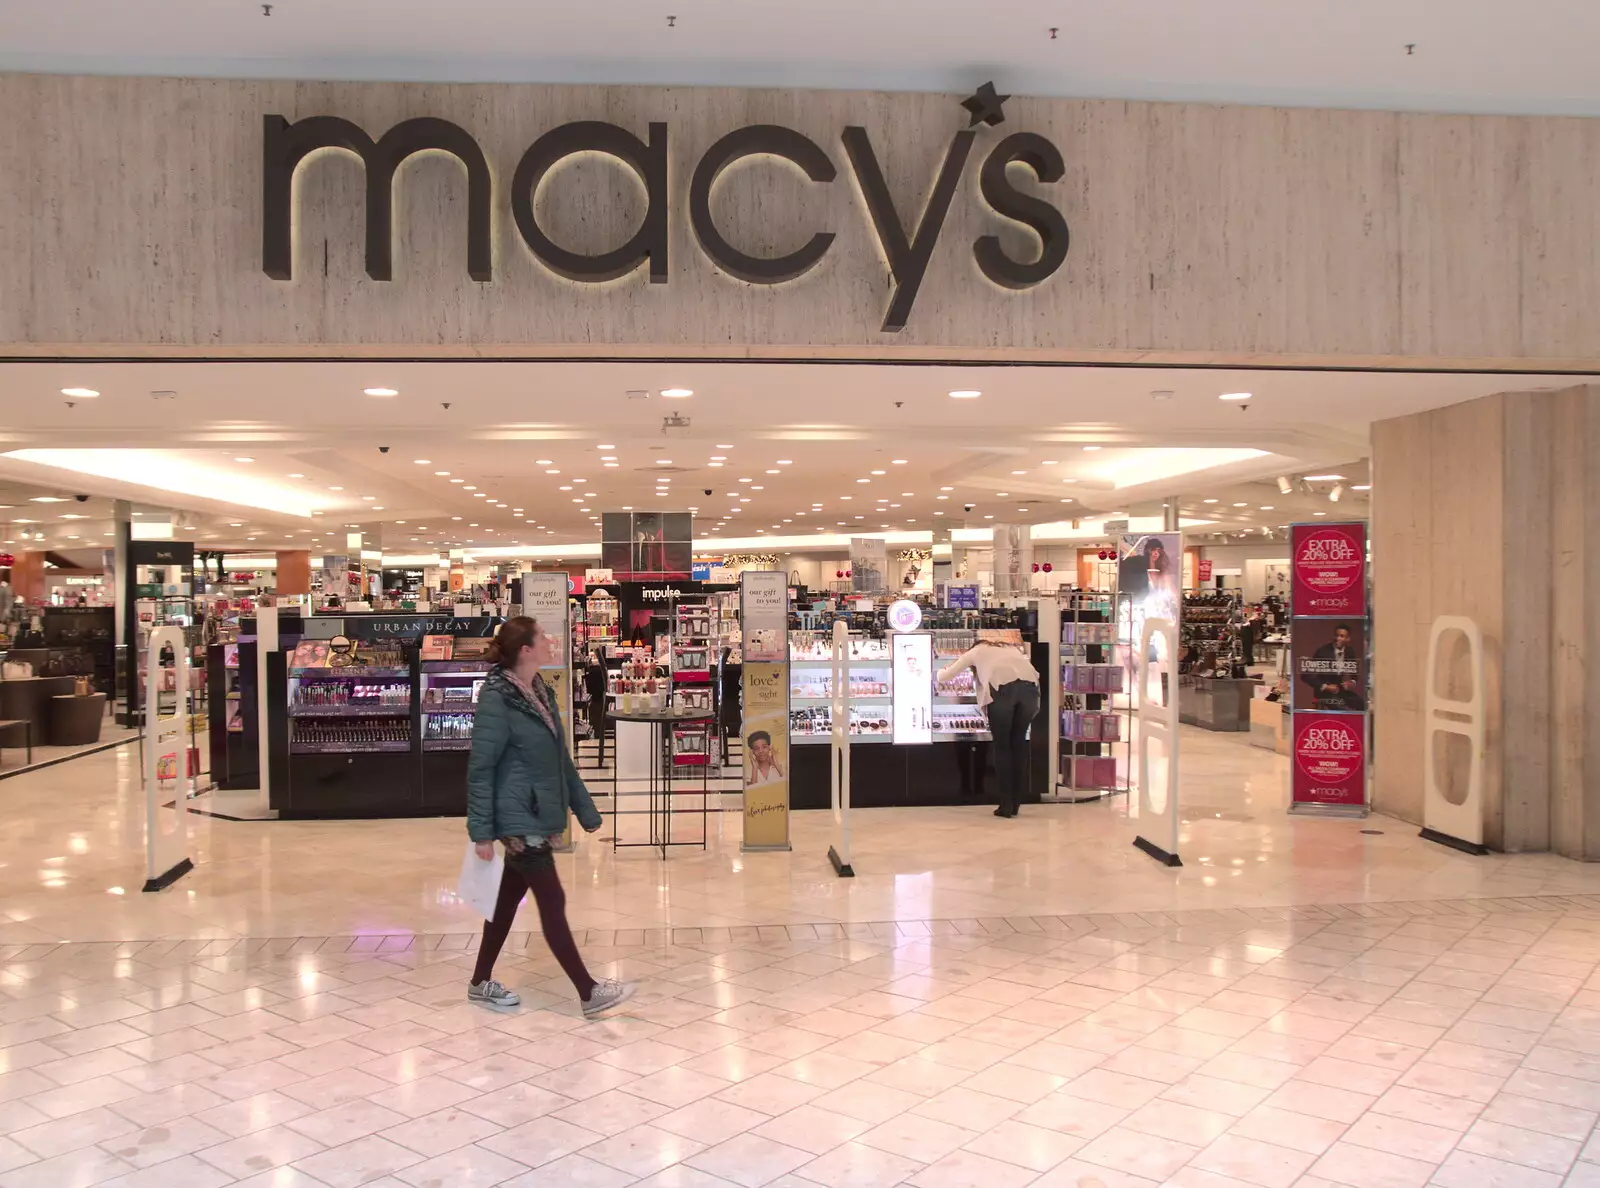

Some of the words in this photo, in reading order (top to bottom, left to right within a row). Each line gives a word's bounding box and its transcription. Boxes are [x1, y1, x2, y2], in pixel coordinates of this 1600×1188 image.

[263, 81, 1070, 332] macy's
[1308, 539, 1349, 551] EXTRA
[1302, 549, 1329, 560] 20%
[1330, 549, 1355, 560] OFF
[544, 590, 557, 598] gift
[642, 585, 681, 601] impulse
[763, 589, 776, 598] gift
[546, 598, 562, 608] you!
[766, 597, 781, 606] you!
[373, 623, 421, 633] URBAN
[425, 622, 471, 631] DECAY
[1301, 660, 1330, 668] LOWEST
[1331, 661, 1358, 669] PRICES
[750, 674, 773, 686] love
[759, 690, 778, 700] sight
[1309, 728, 1349, 740] EXTRA
[1303, 738, 1329, 749] 20%
[1330, 739, 1355, 750] OFF
